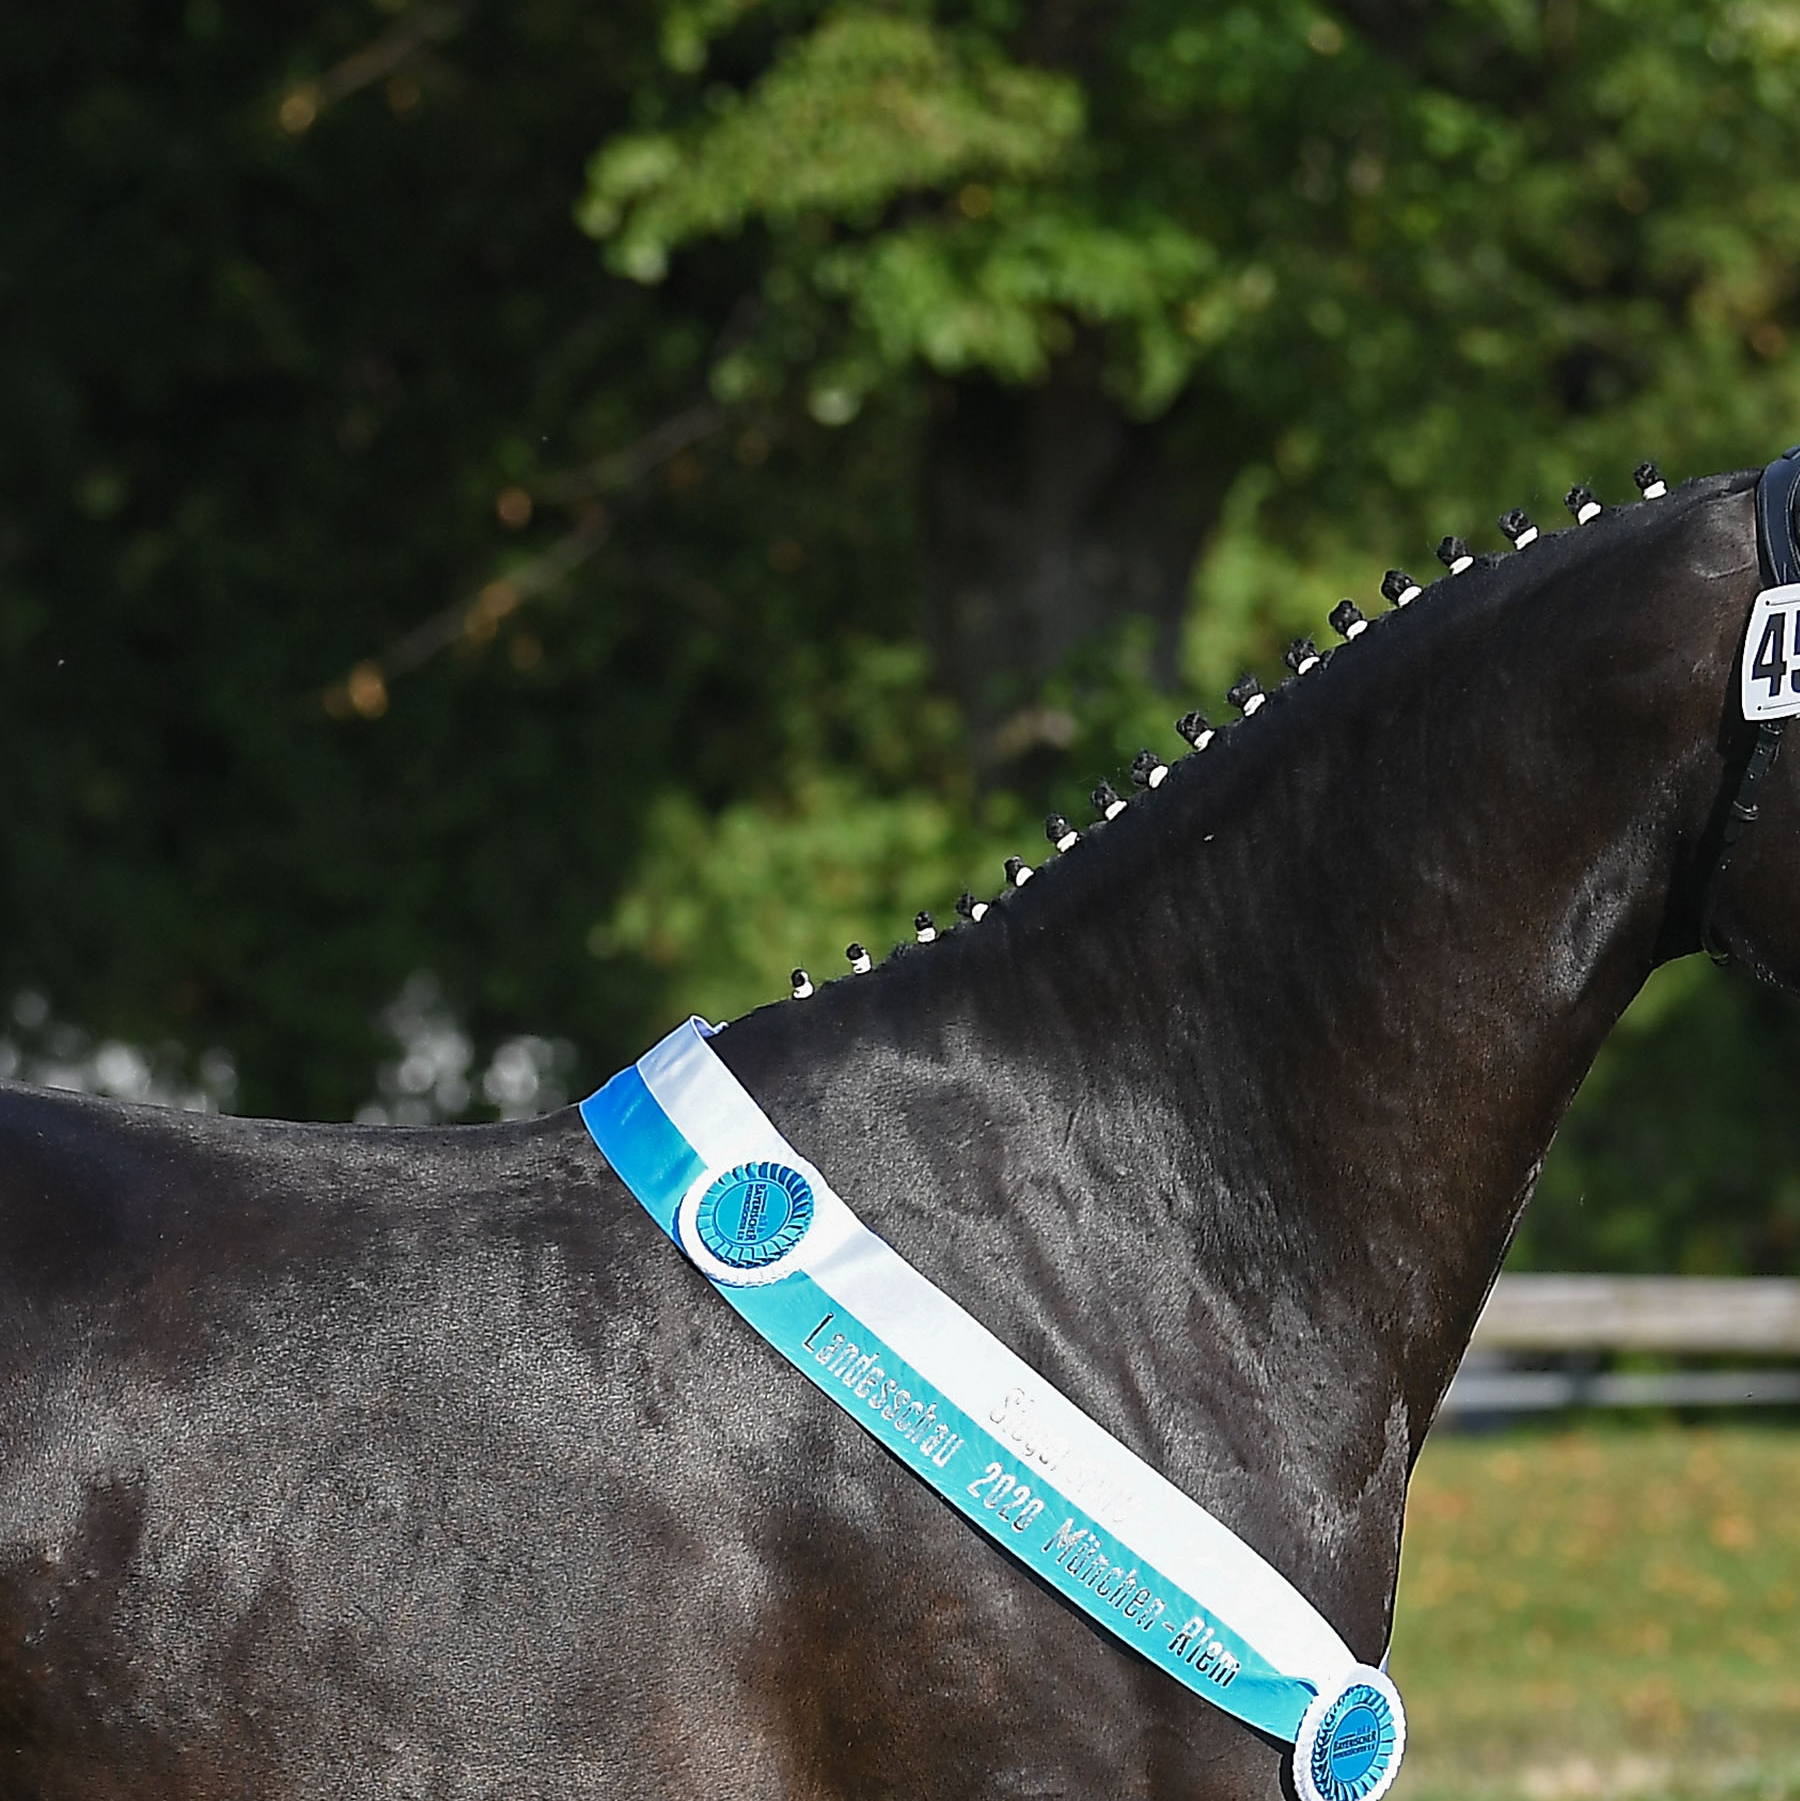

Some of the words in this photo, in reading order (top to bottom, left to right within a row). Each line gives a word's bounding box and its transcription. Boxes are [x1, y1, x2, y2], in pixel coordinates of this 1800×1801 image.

[745, 1183, 767, 1241] BAYERISCHER
[802, 1312, 964, 1468] Landesschau
[967, 1462, 1045, 1533] 2020
